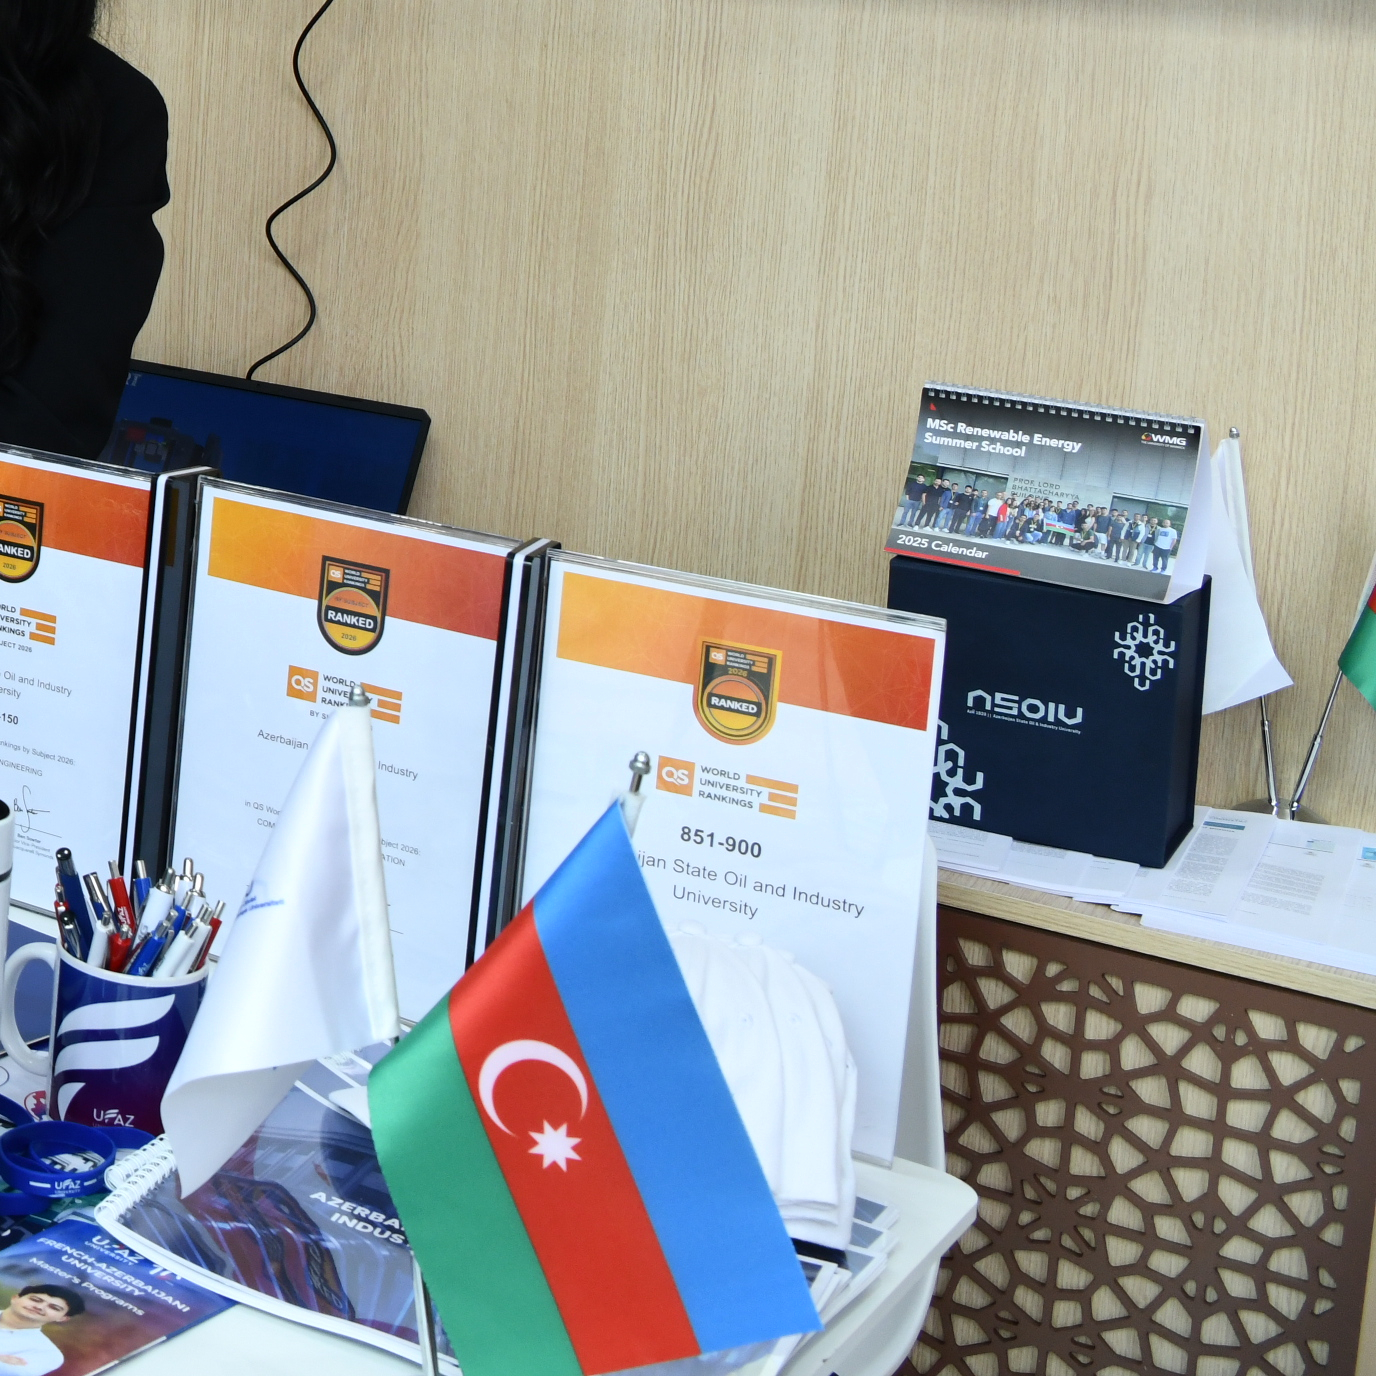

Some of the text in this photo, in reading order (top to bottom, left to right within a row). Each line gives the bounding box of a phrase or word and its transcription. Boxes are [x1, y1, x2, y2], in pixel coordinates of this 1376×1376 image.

[924, 432, 1025, 457] Summer School
[927, 417, 1082, 453] MSc Renewable Energy
[1152, 434, 1186, 445] WMG
[1012, 484, 1079, 500] BHATTACHARYYA
[897, 534, 989, 559] 2025 Calendar
[3, 562, 16, 570] 2026
[328, 610, 373, 629] RANKED
[341, 633, 356, 641] 2026
[18, 644, 33, 653] 2026
[728, 668, 748, 677] 2026
[3, 670, 16, 681] Oil
[18, 674, 35, 686] and
[37, 679, 72, 698] Industry
[291, 674, 356, 693] QS WORLD
[309, 710, 319, 718] BY
[711, 696, 757, 713] RANKED
[22, 744, 30, 754] by
[32, 748, 56, 761] Subject
[57, 755, 76, 766] 2026:
[257, 729, 418, 781] Azerbaijan Industry
[662, 765, 741, 786] QS WORLD
[699, 777, 762, 798] UNIVERSITY
[699, 790, 753, 809] RANKINGS
[245, 799, 251, 808] in
[253, 802, 264, 811] QS
[265, 805, 280, 816] Wor
[381, 838, 399, 850] bject
[680, 826, 762, 858] 851-900
[673, 858, 718, 882] State
[724, 871, 748, 889] Oil
[753, 879, 786, 897] and
[793, 886, 865, 919] Industry
[673, 884, 759, 920] University
[93, 1108, 135, 1128] UFAZ
[55, 1179, 81, 1190] UFAZ
[330, 1213, 410, 1247] INDUS
[85, 1241, 134, 1266] UNIVERSITY
[37, 1237, 191, 1313] FRENCH-AZERBAIJANI
[61, 1255, 146, 1297] UNIVERSITY
[29, 1257, 145, 1316] Master's Programs
